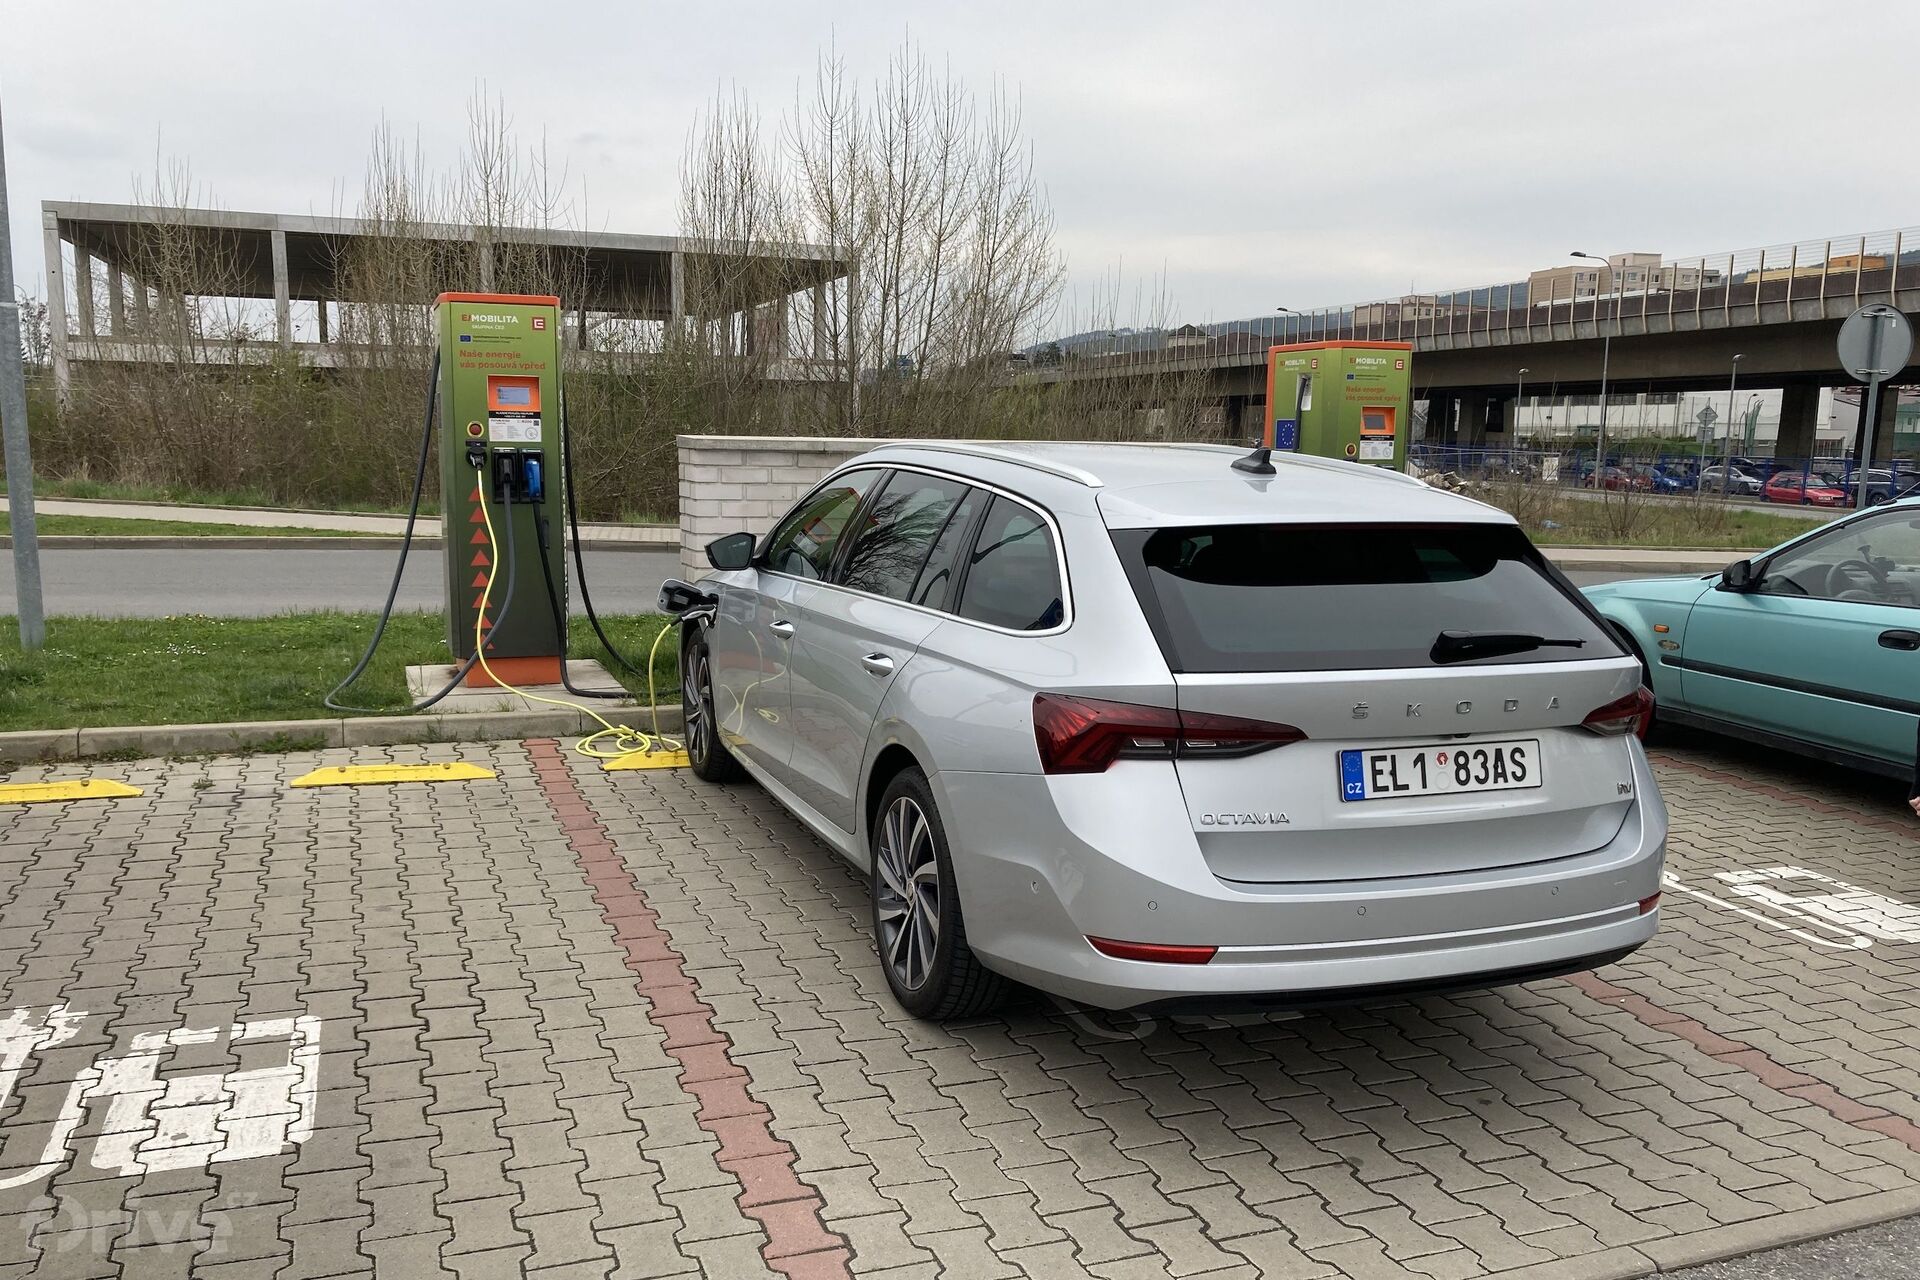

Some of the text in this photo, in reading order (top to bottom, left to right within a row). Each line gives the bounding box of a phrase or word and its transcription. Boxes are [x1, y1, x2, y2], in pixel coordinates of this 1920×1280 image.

[460, 349, 521, 360] Naše energie
[1352, 697, 1560, 720] ŠKODA
[1370, 747, 1527, 793] EL1 83AS
[1347, 782, 1362, 794] CZ
[1200, 812, 1290, 826] OCTAVIA
